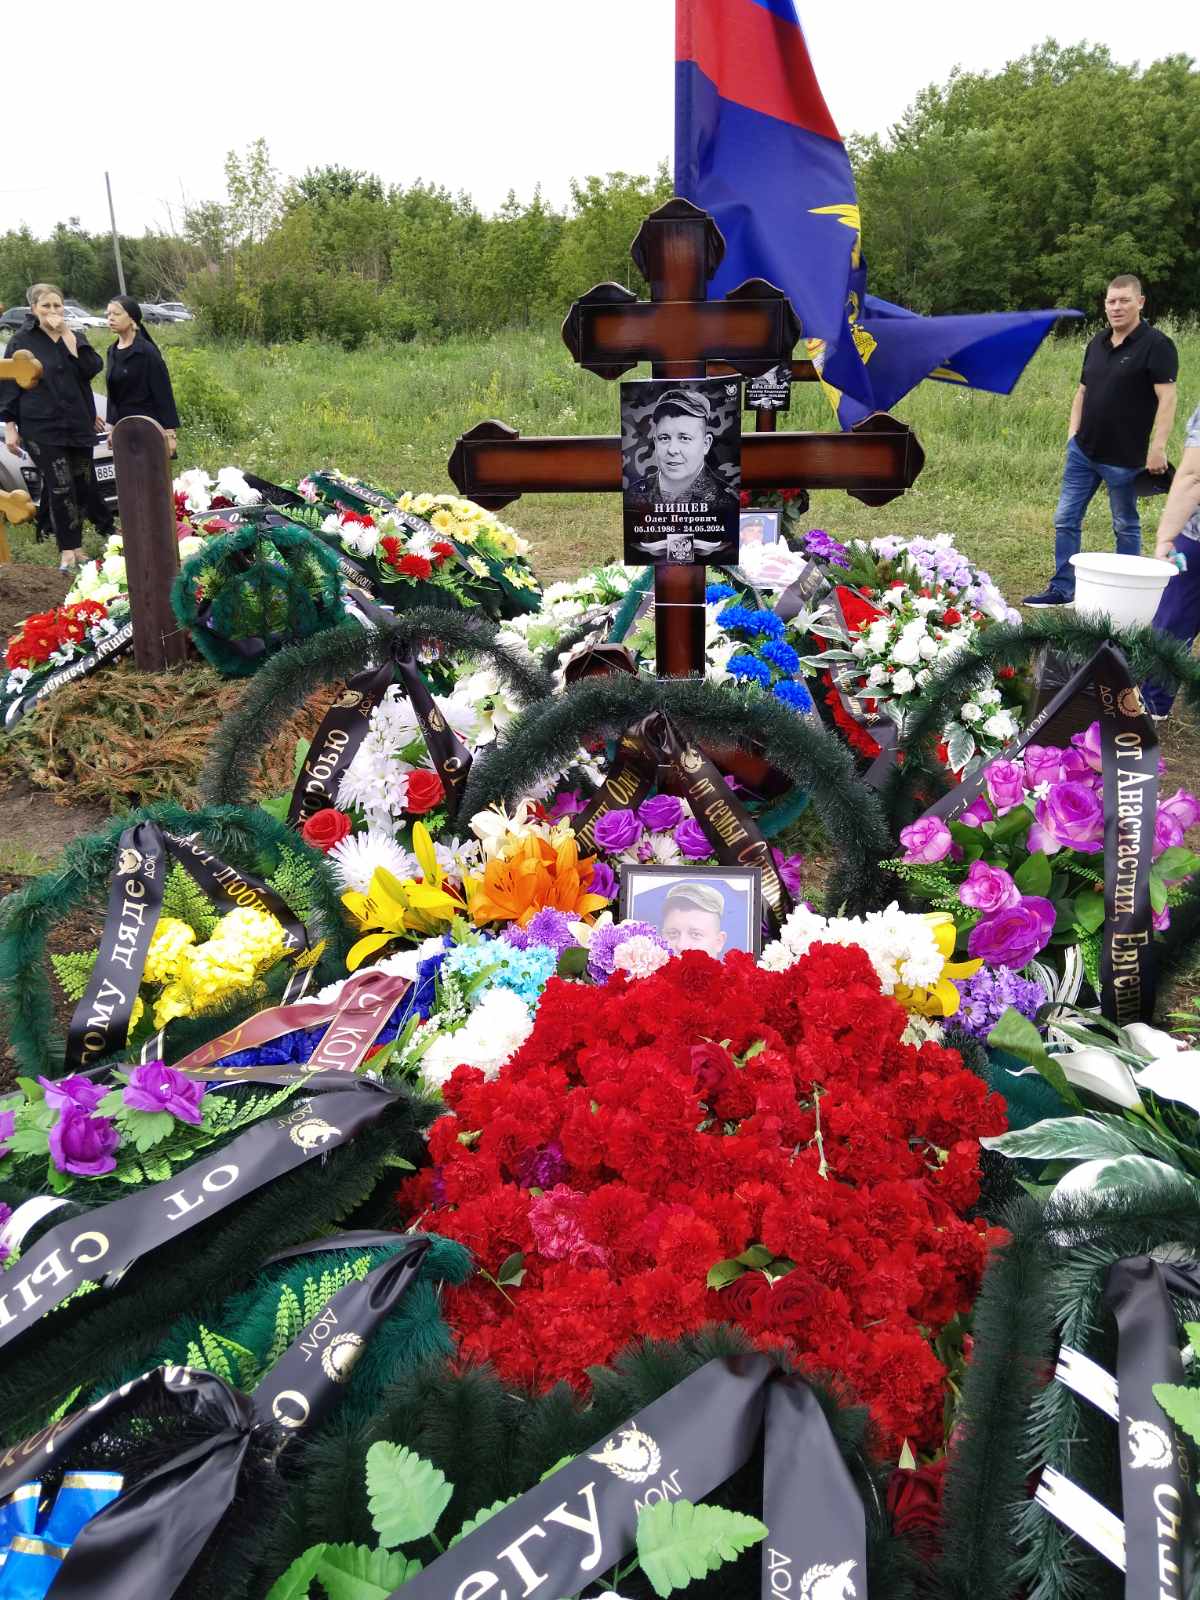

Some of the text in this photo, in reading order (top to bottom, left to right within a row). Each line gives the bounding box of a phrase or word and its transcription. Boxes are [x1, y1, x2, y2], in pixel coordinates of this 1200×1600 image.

[644, 514, 718, 524] Олег Петрович
[654, 502, 709, 514] НИЩЕВ
[1099, 684, 1117, 718] ДОЛГ
[1114, 732, 1143, 761] от
[688, 777, 716, 801] от
[704, 799, 749, 848] семьи
[144, 853, 157, 880] ДОЛГ
[111, 879, 146, 970] дяде
[163, 1164, 241, 1222] от
[299, 1307, 341, 1363] ДОЛГ
